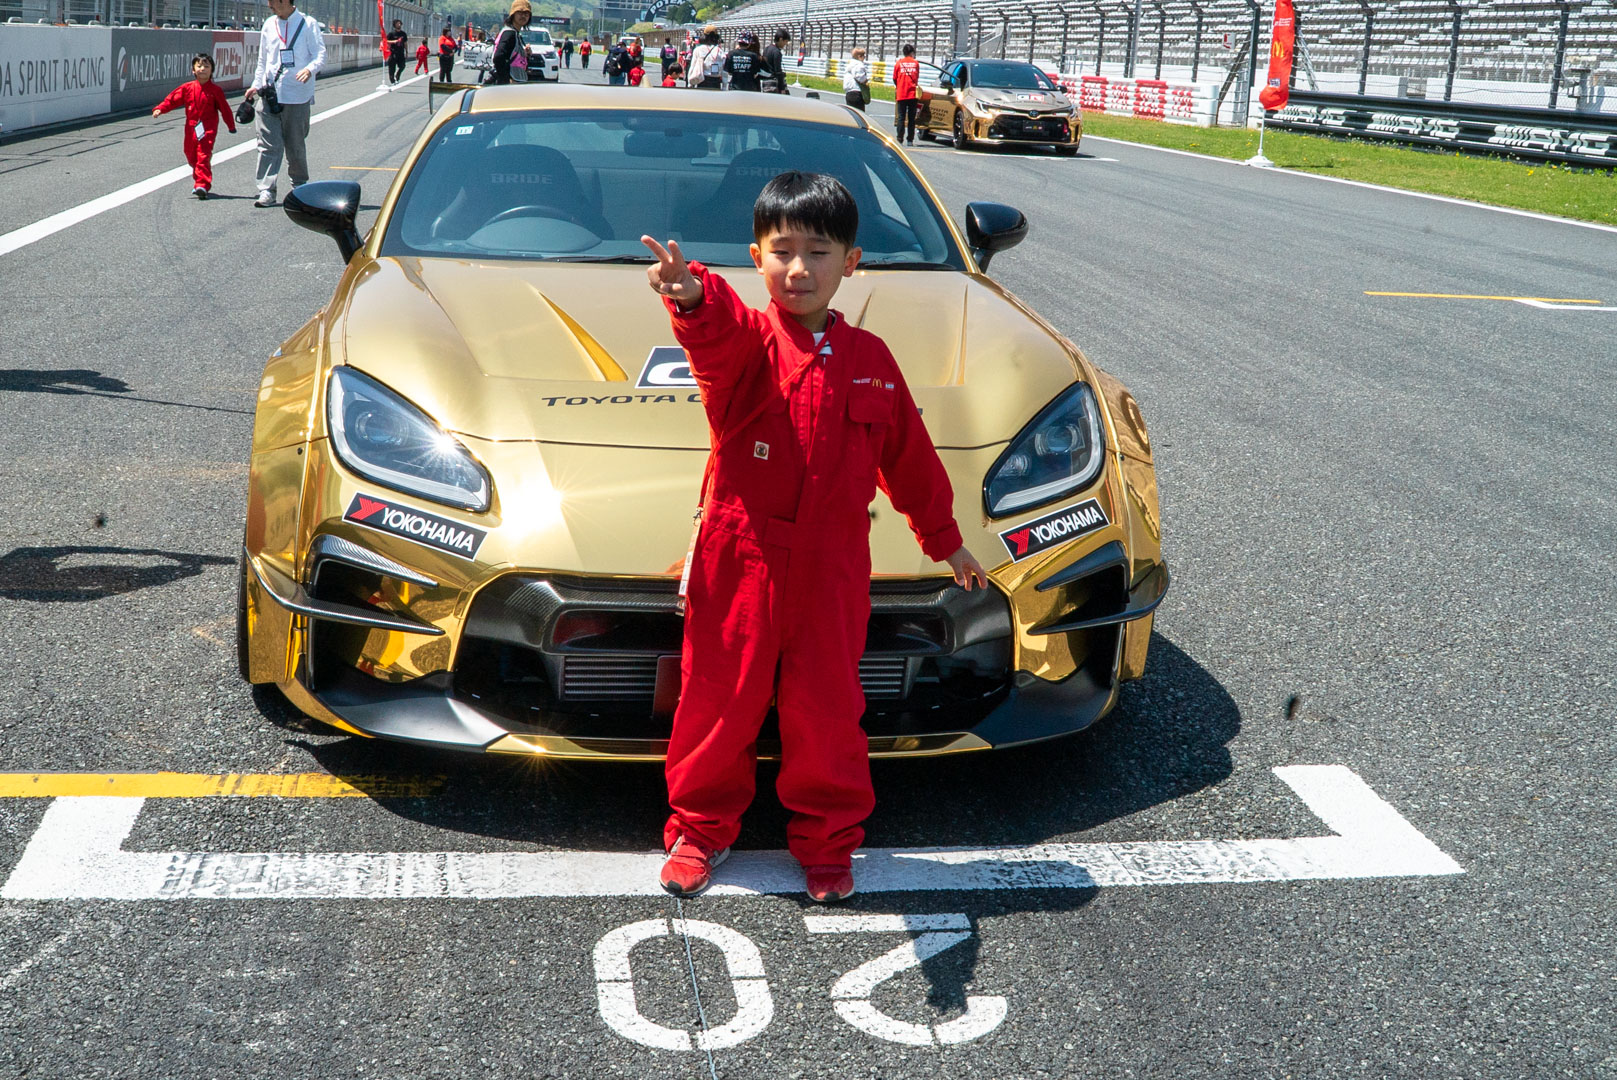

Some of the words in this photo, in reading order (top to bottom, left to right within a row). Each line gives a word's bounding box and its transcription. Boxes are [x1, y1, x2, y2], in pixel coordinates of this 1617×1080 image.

[18, 60, 59, 96] SPIRIT
[63, 56, 105, 91] RACING
[130, 54, 161, 82] MAZDA
[163, 53, 185, 79] SPIRIT
[491, 173, 553, 185] BRIDE
[541, 394, 676, 407] TOYOTA
[381, 507, 476, 552] YOKOHAMA
[1030, 506, 1104, 544] YOKOHAMA
